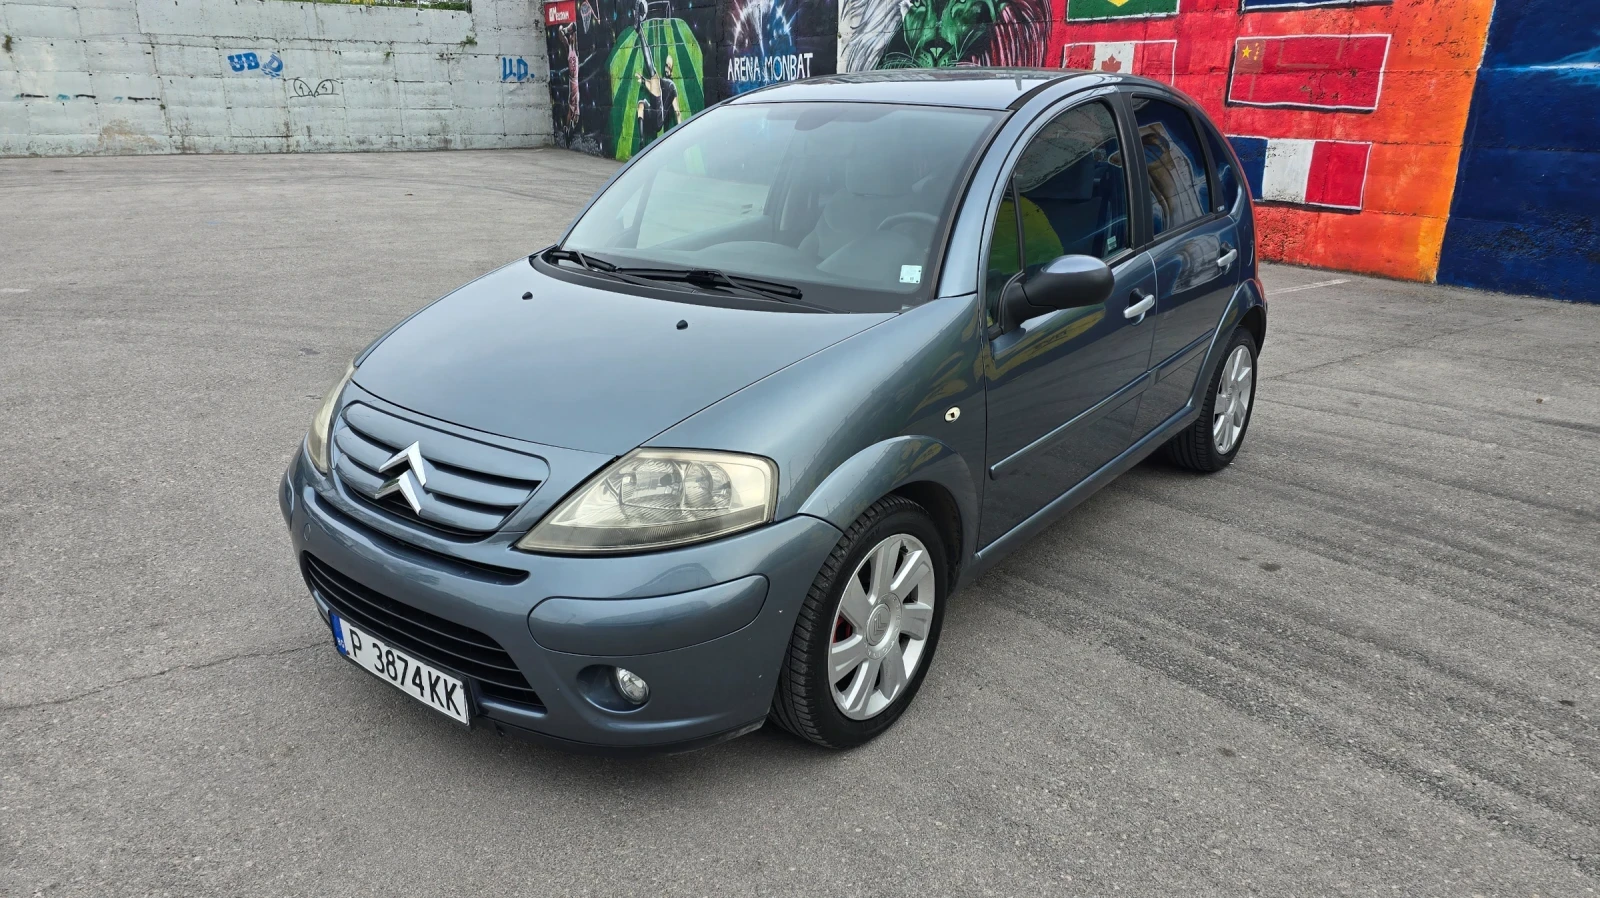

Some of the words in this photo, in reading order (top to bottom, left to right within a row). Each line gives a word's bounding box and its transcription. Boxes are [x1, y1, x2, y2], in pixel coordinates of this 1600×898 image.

[728, 56, 761, 81] ARENA
[763, 53, 813, 81] MONBAT
[349, 628, 362, 657] P
